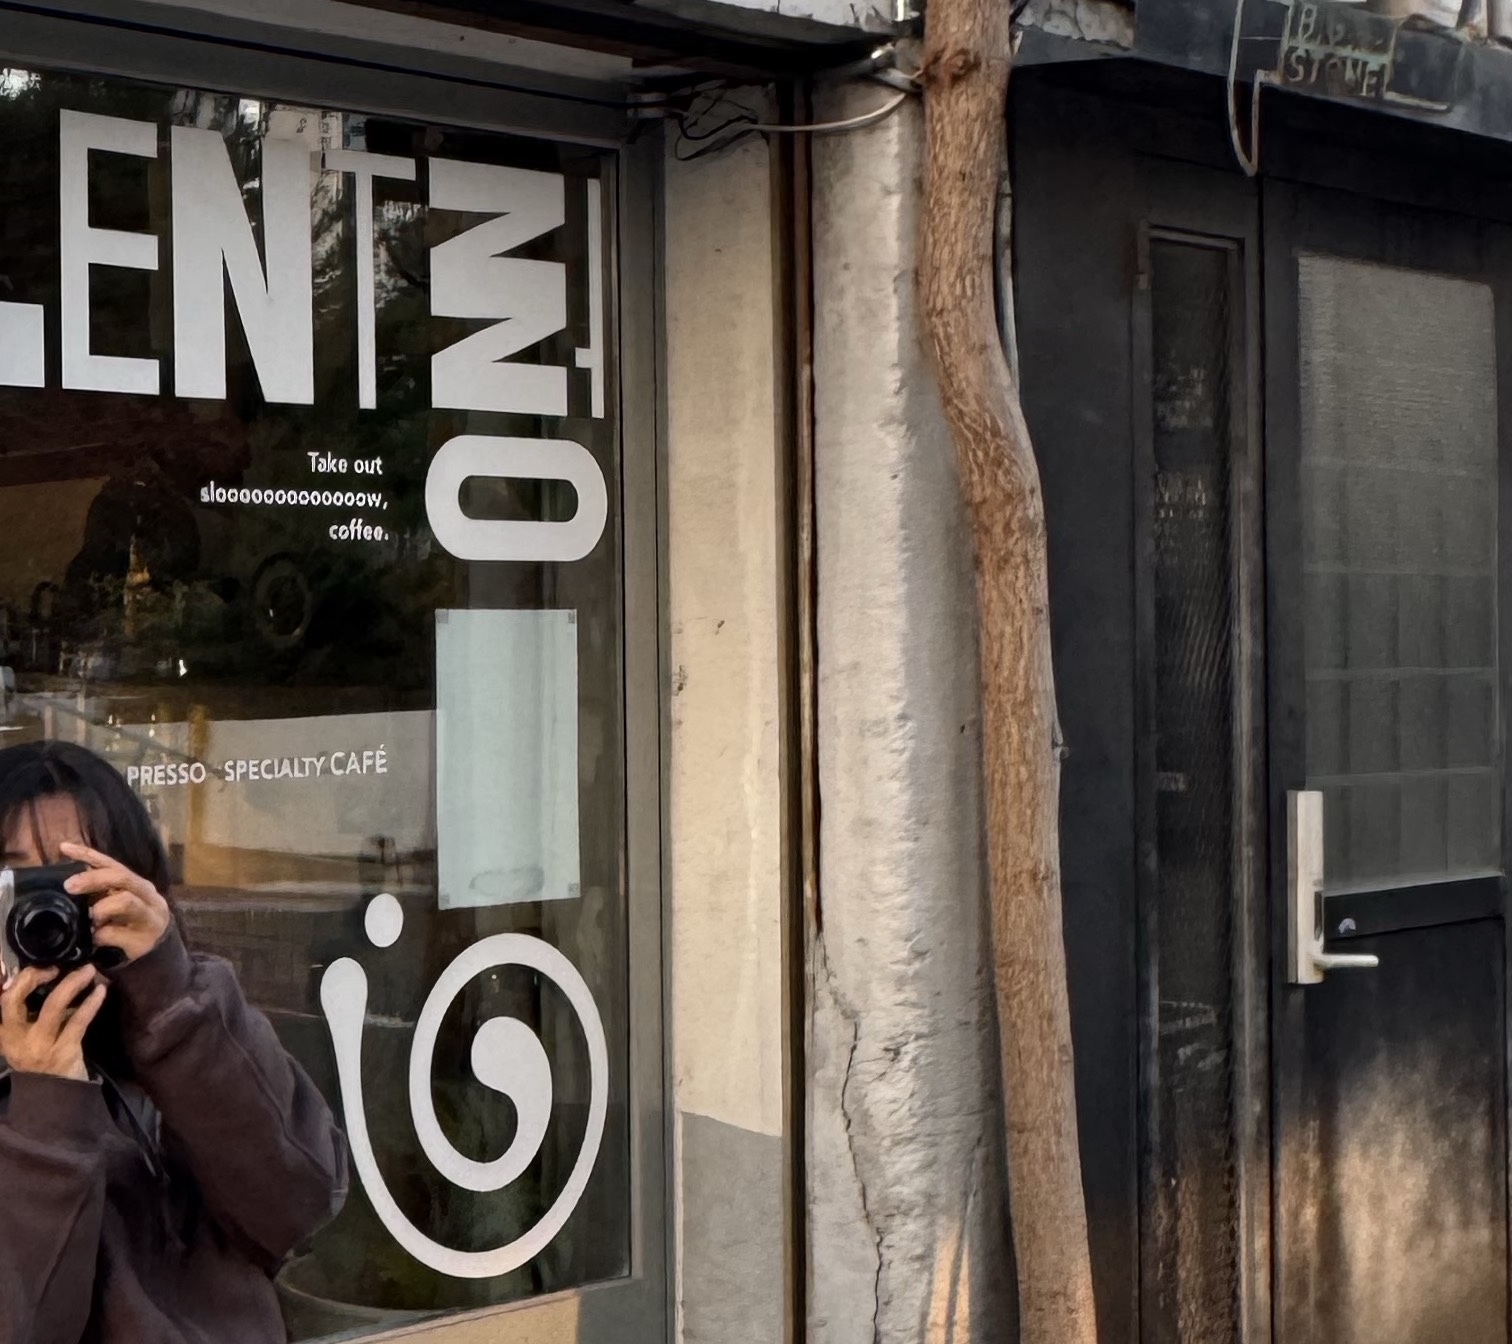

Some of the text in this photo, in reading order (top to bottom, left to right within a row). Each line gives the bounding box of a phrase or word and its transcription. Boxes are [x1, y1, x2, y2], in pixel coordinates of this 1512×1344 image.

[307, 451, 383, 475] Take out
[329, 518, 389, 541] coffee.
[127, 744, 388, 787] PRESSO SPECIALTY CAFÉ
